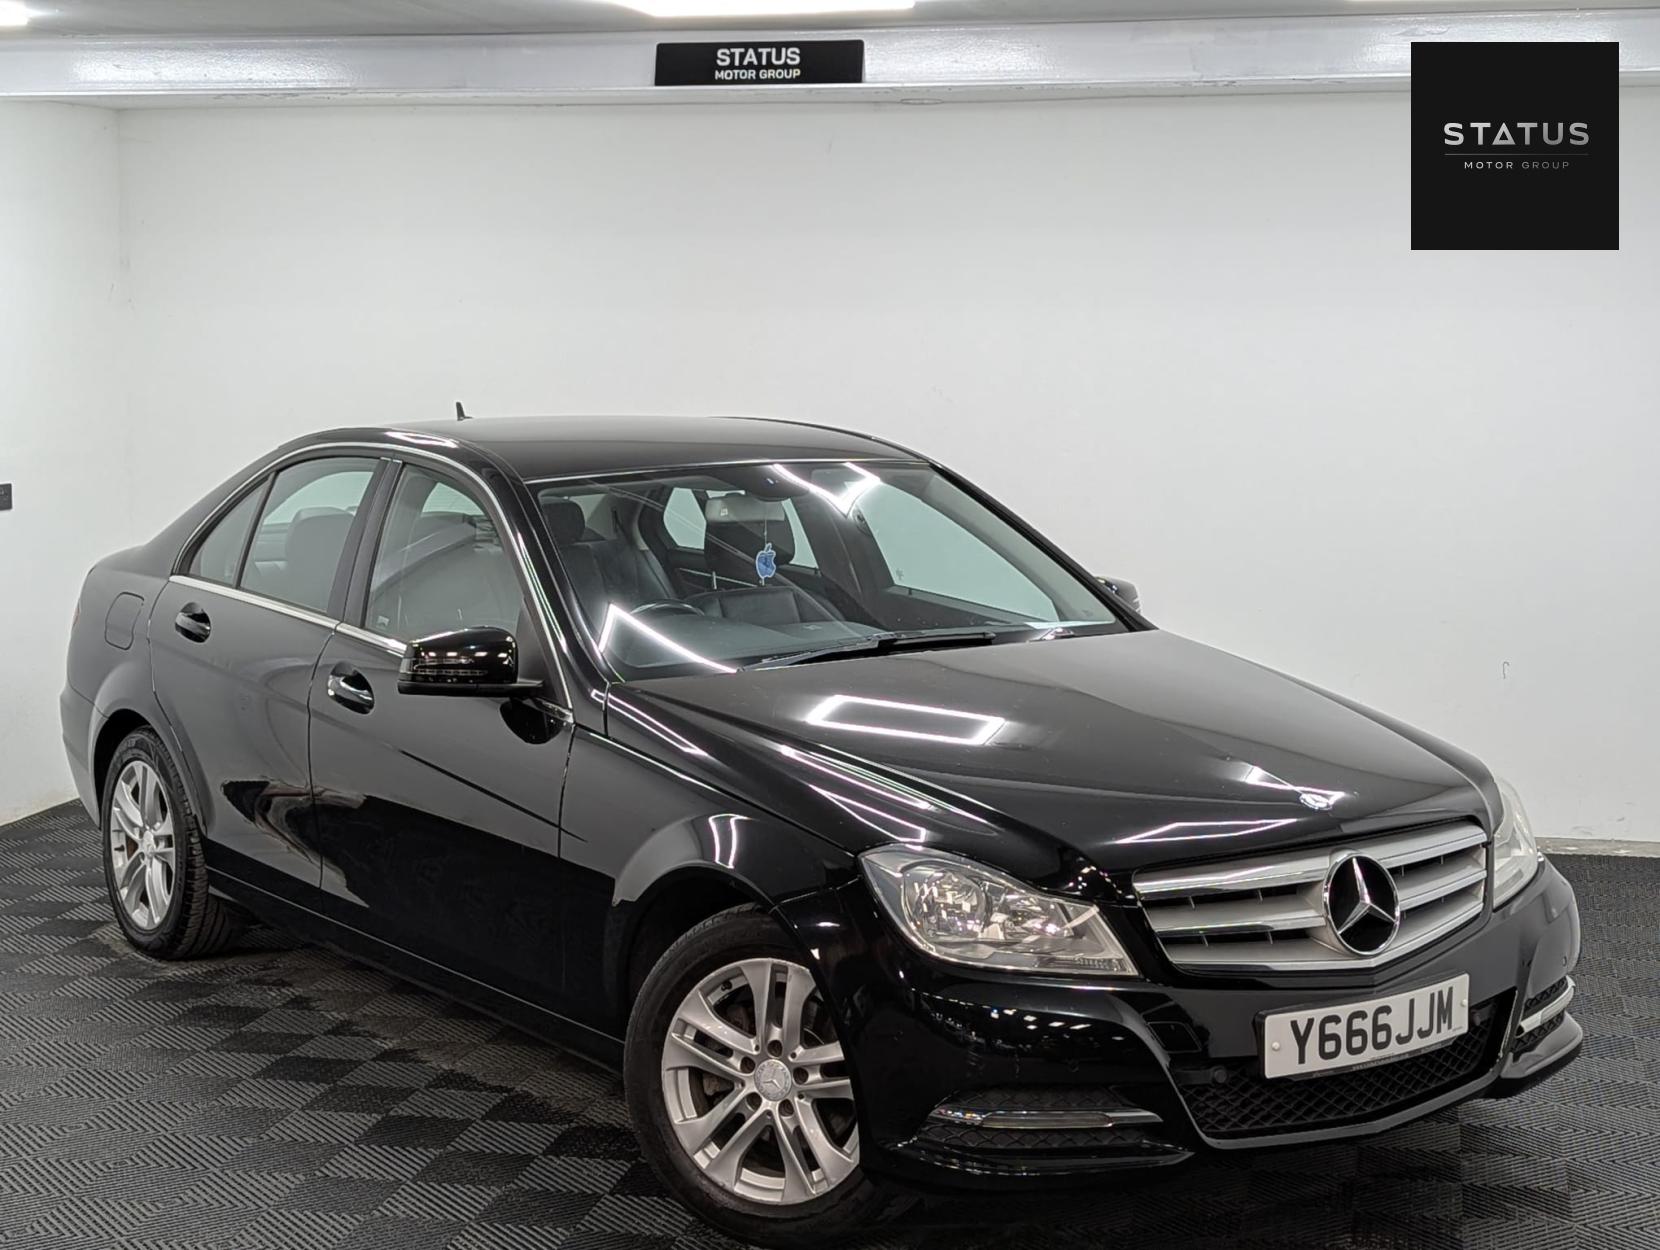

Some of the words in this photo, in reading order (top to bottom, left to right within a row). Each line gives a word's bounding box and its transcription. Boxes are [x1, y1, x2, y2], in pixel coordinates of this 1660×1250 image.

[716, 47, 800, 66] STATUS
[714, 69, 757, 80] MOTOR
[759, 68, 801, 80] GROUP
[1290, 986, 1454, 1066] Y666JJM
